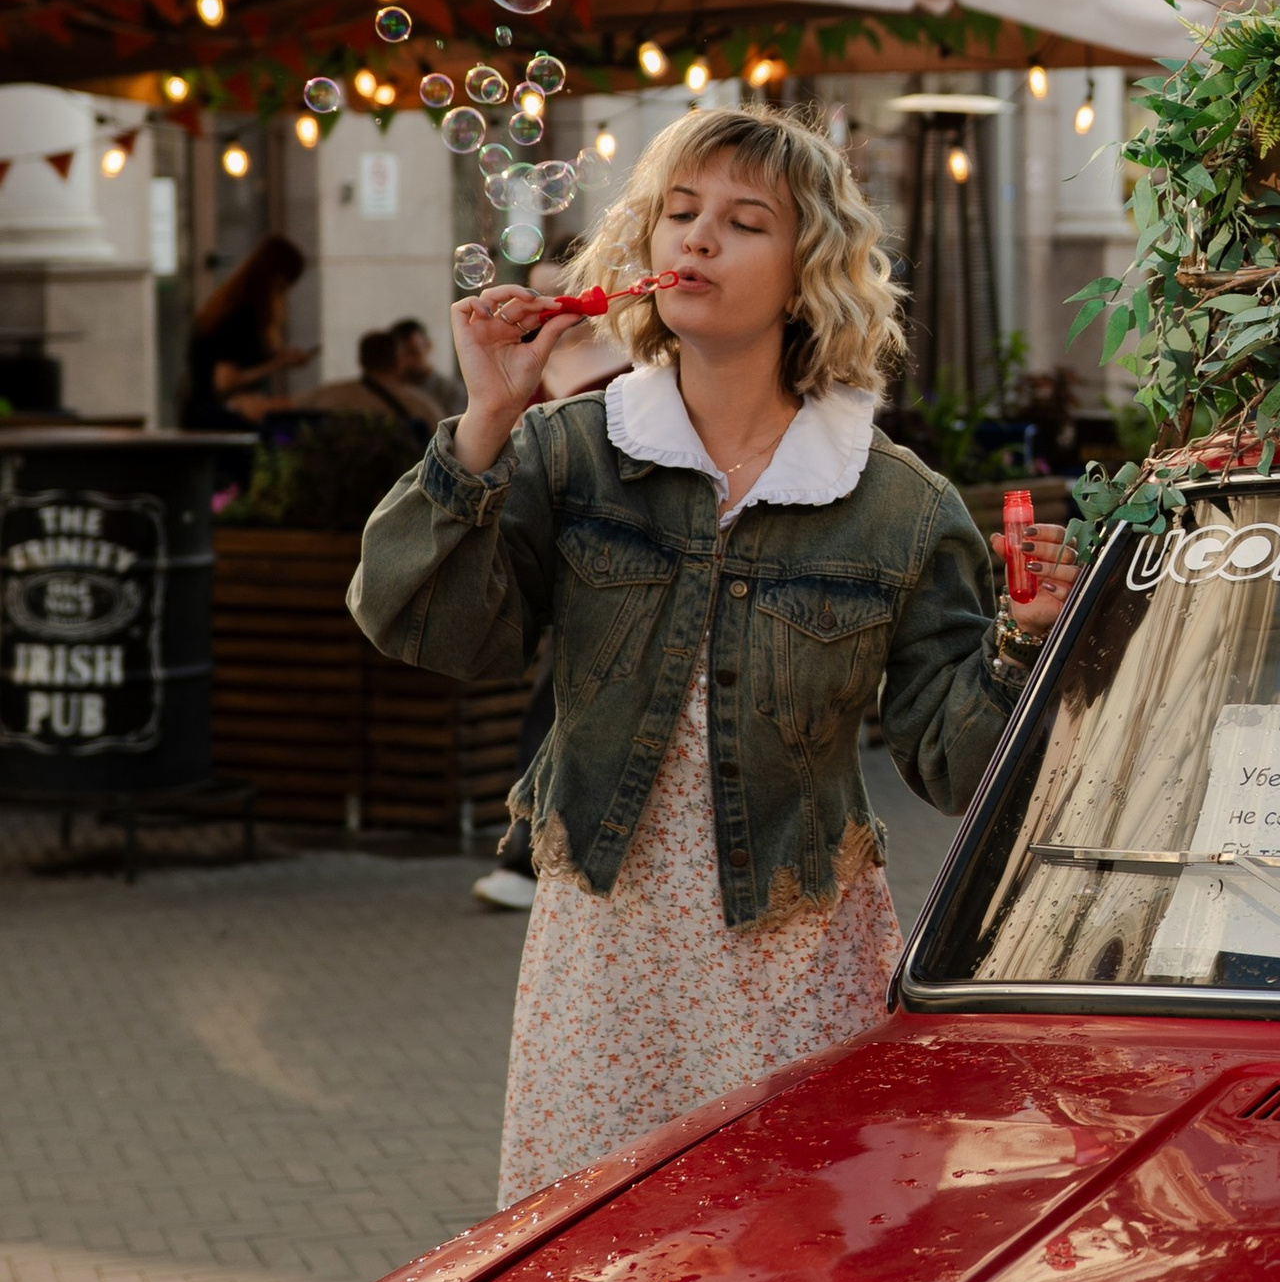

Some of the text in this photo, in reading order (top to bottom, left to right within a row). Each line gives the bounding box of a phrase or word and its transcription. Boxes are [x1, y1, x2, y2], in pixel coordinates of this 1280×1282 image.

[38, 506, 103, 538] THE
[9, 538, 137, 572] TRINITY
[13, 643, 123, 685] IRISH
[28, 691, 106, 737] PUB
[1228, 809, 1257, 825] не
